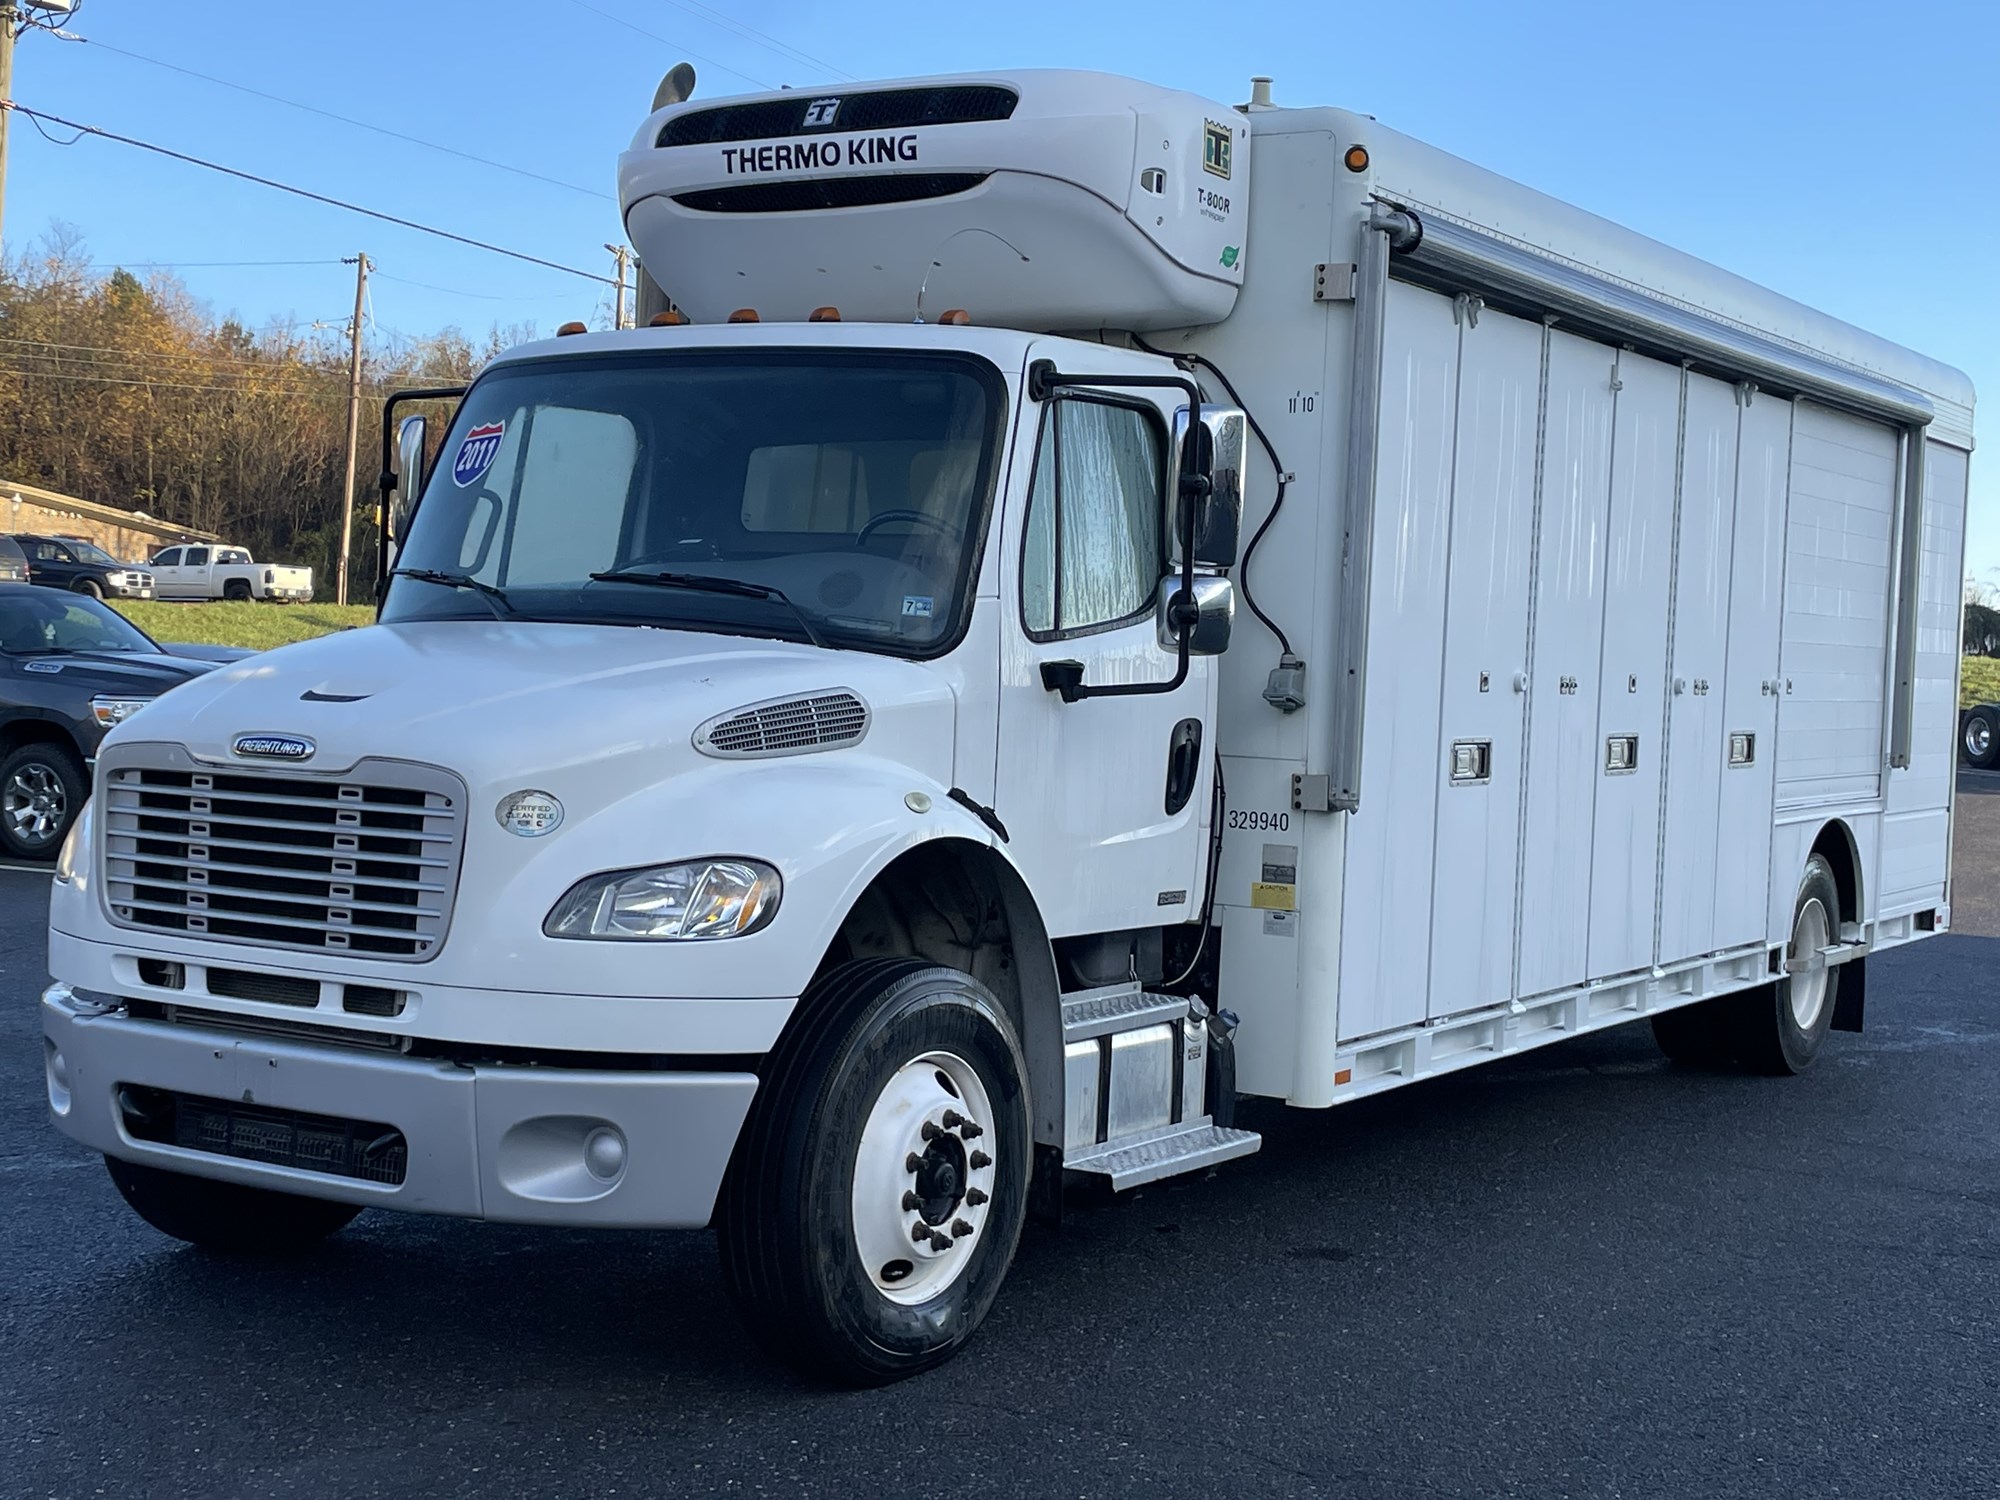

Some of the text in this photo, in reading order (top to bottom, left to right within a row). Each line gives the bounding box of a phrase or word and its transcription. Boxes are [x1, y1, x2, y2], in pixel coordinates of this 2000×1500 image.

[722, 135, 918, 173] THERMO KING
[1198, 187, 1230, 214] T-800R
[457, 438, 497, 472] 2011
[906, 600, 914, 612] 7
[239, 740, 303, 754] FREIGHTLINER
[511, 804, 552, 812] CERTIFIED
[1228, 810, 1290, 832] 329940
